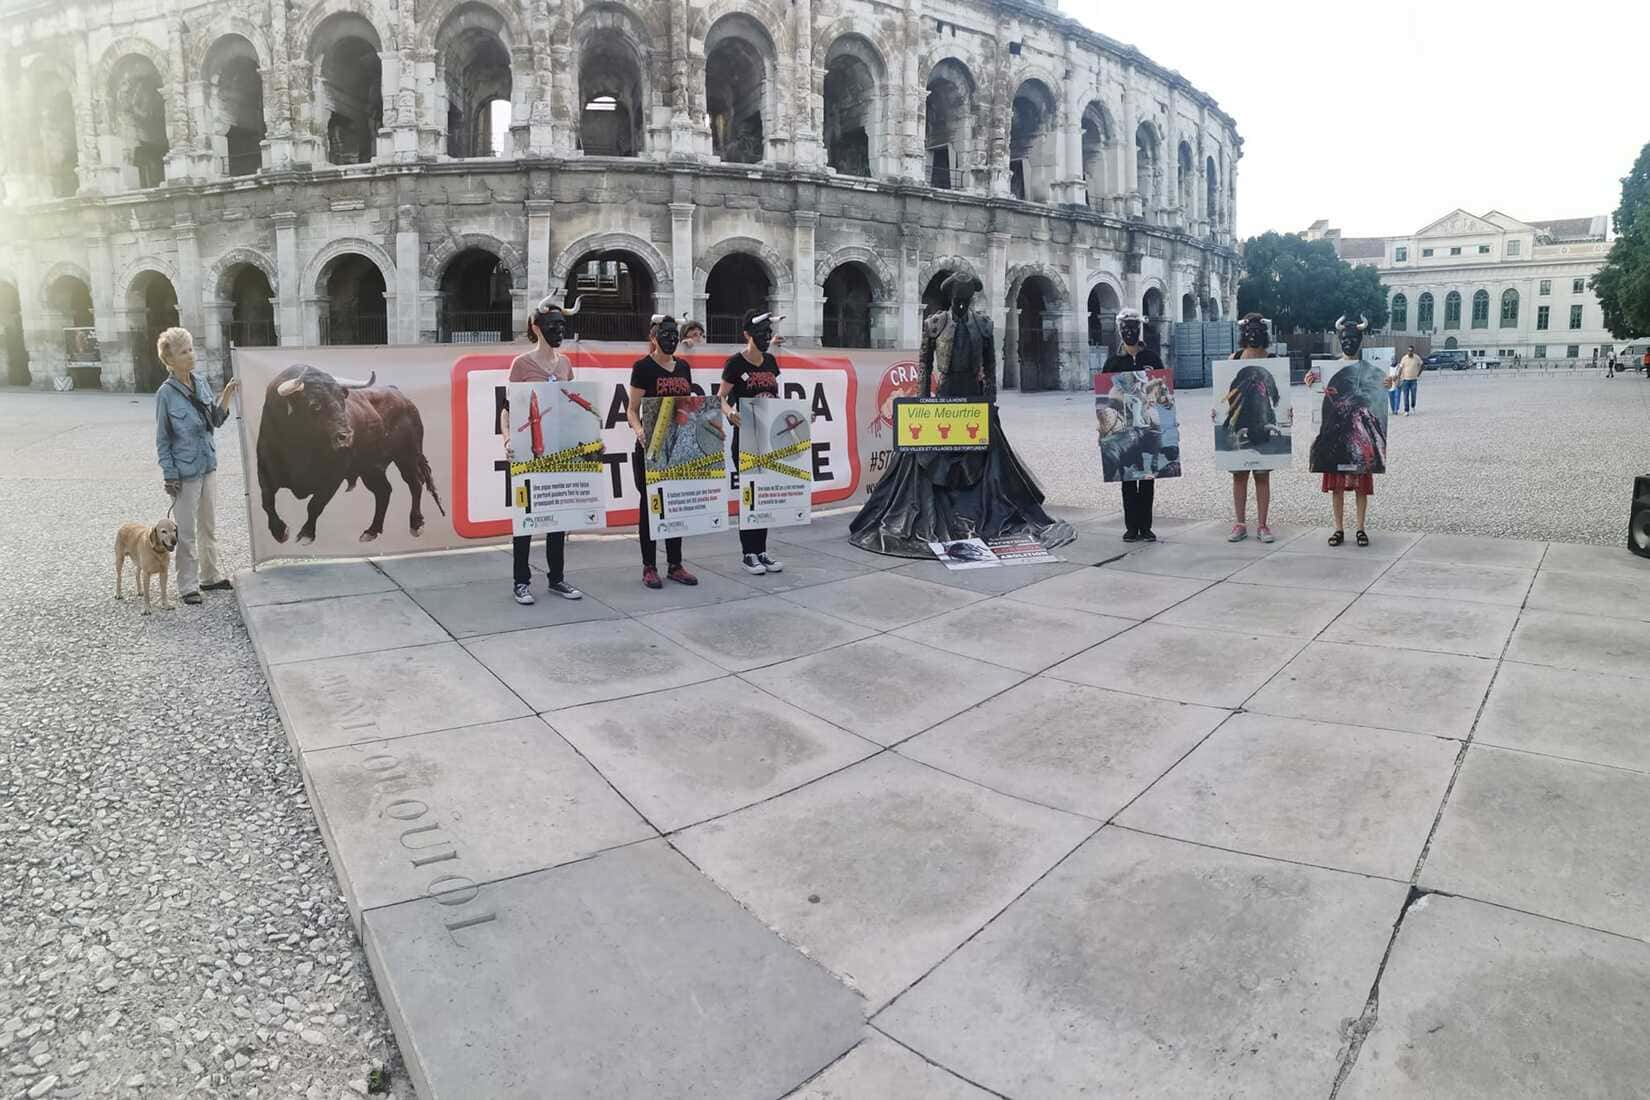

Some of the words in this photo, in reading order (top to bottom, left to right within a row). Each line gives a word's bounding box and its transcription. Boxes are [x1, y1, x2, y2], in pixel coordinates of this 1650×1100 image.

[890, 365, 919, 386] CRA
[907, 407, 931, 418] Ville
[934, 407, 982, 418] Meurtrie
